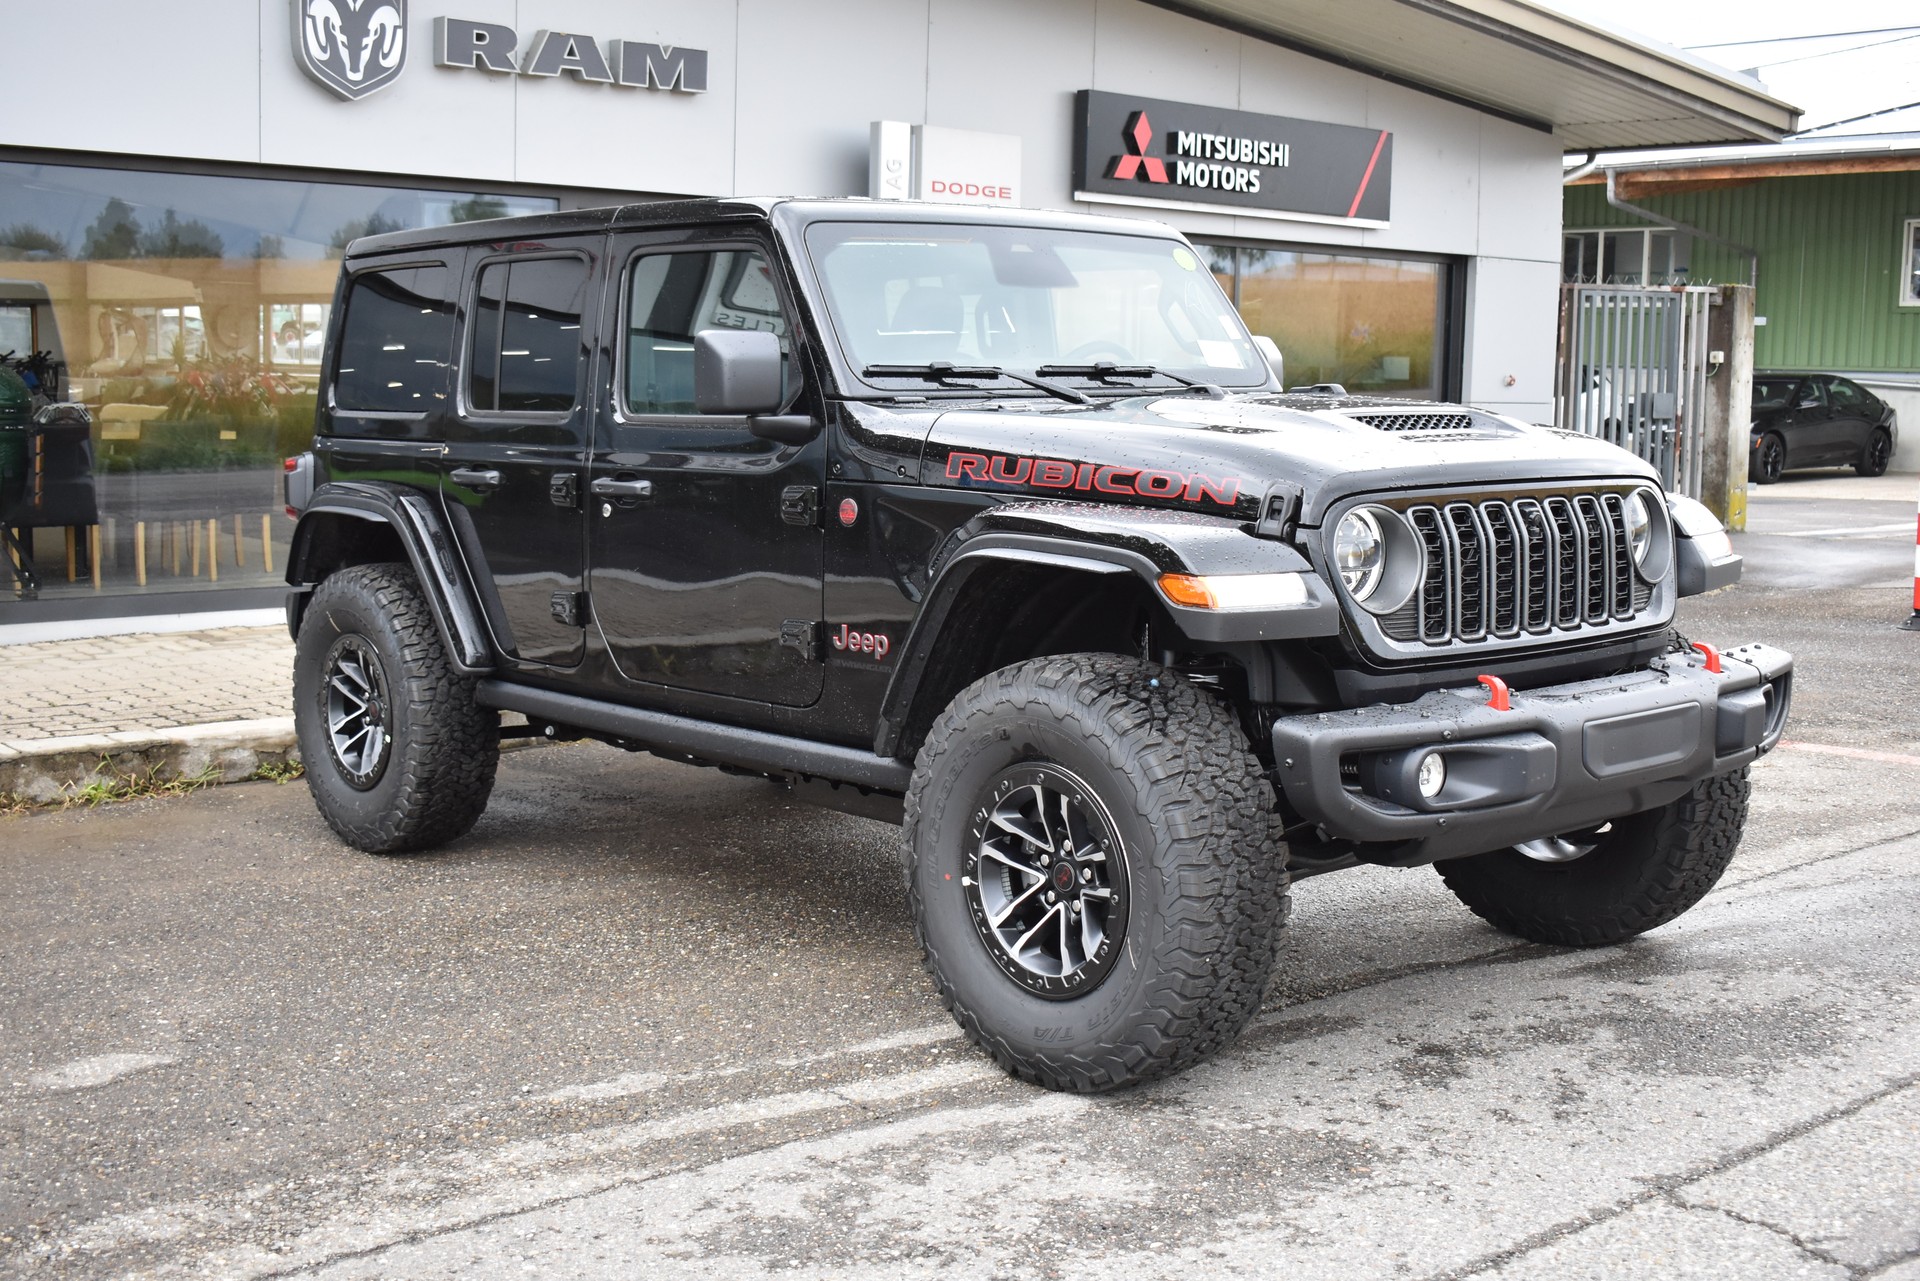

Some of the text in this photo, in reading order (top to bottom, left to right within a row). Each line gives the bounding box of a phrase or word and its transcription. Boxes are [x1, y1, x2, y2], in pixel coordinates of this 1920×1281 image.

[434, 16, 708, 94] RAM
[1177, 130, 1289, 167] MITSUBISHI
[886, 158, 903, 191] AG
[931, 180, 1012, 199] DODGE
[1176, 160, 1261, 193] MOTORS
[945, 452, 1242, 506] RUBICON
[832, 623, 889, 660] Jeep
